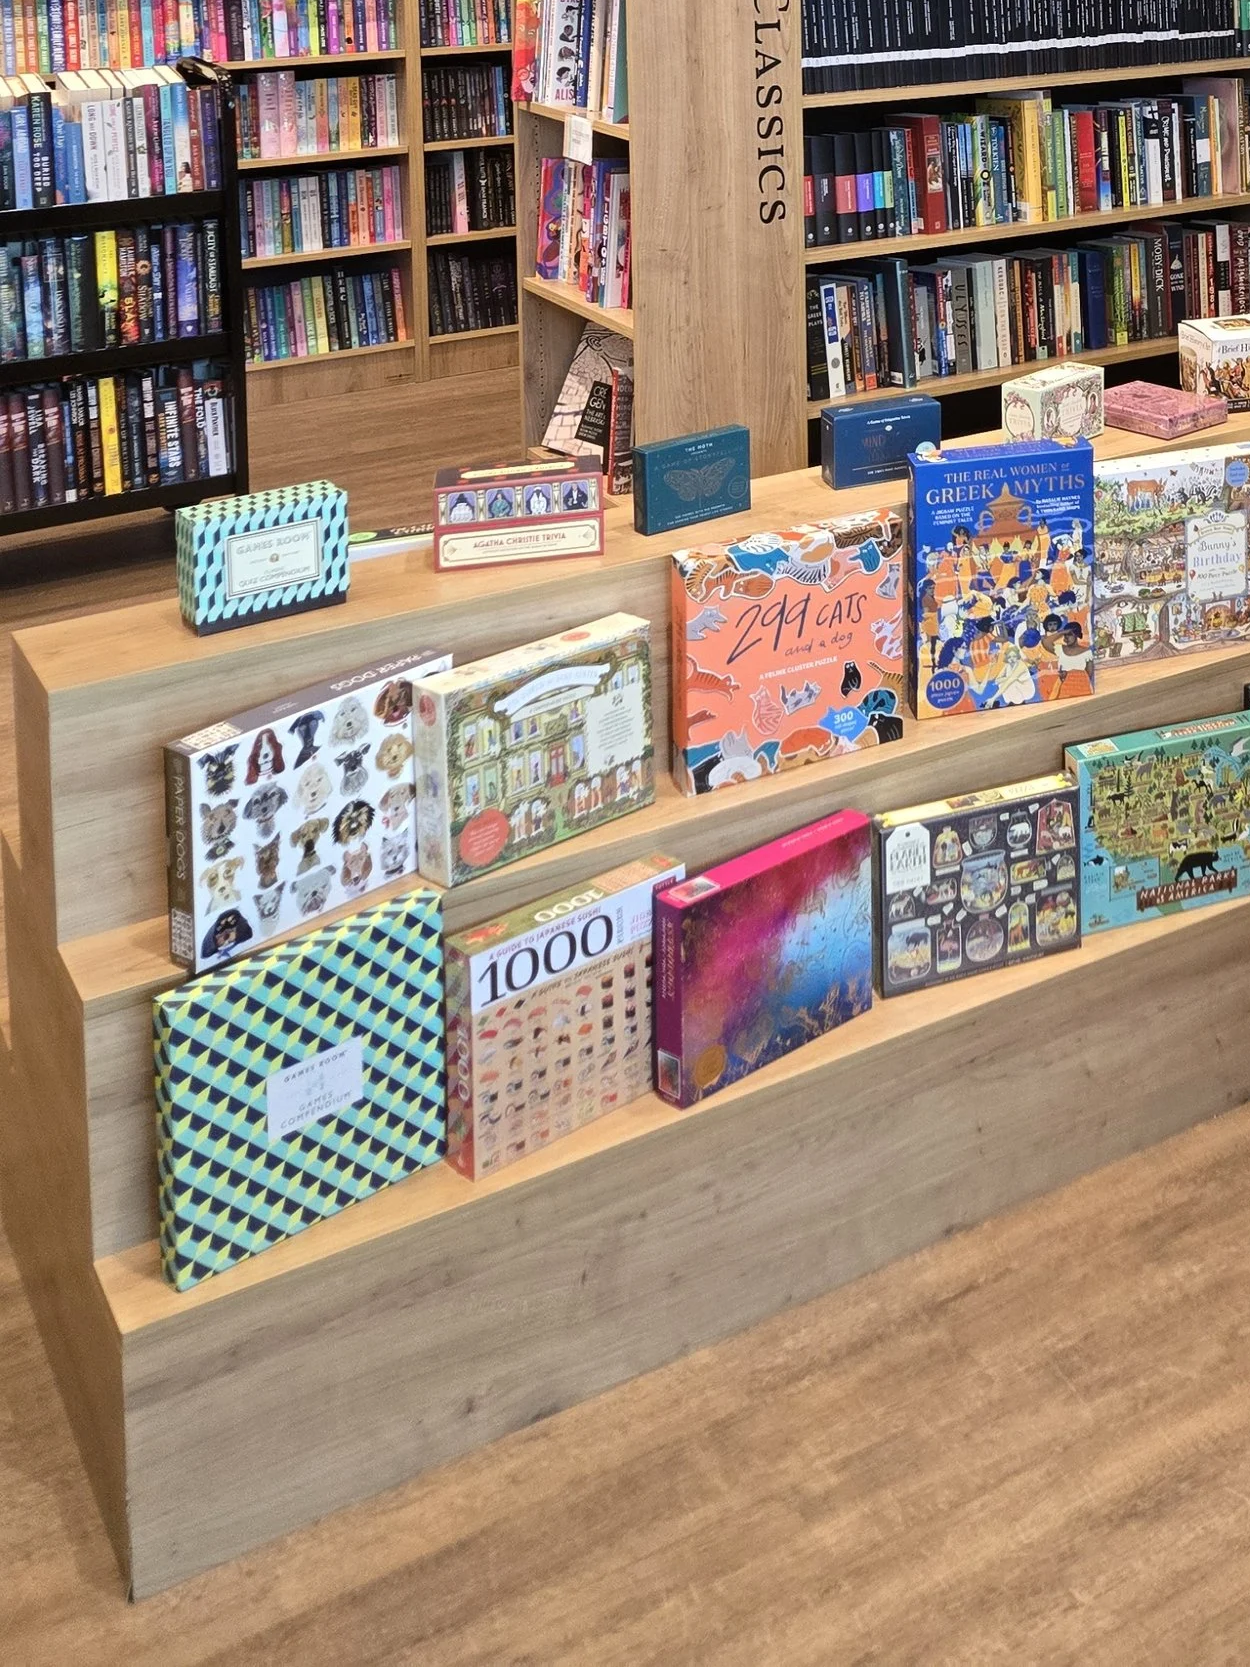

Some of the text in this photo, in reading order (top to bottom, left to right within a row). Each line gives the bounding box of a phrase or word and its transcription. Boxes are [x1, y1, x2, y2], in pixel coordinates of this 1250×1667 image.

[31, 95, 42, 149] KAREN ROSE
[955, 284, 967, 347] ULYSSES
[1221, 344, 1239, 354] Brief
[165, 401, 181, 468] INFINITE STARS
[944, 463, 1057, 484] THE REAL WOMEN
[926, 473, 1085, 506] GREEK MYTHS
[236, 532, 312, 556] GAMES ROOM
[473, 532, 566, 548] AGATHA CHRISTIE TRIVIA
[1198, 537, 1237, 552] Bunny's
[1193, 552, 1243, 570] Birthday
[726, 591, 868, 665] 299 CATS
[784, 631, 854, 657] and dog
[787, 655, 838, 675] CLUSTER PUZZLE
[930, 678, 961, 691] 1000
[833, 711, 854, 722] 300
[173, 773, 188, 882] PAPER DOGS
[1140, 869, 1236, 900] NATIONAL PARKS
[478, 914, 613, 1008] 1000
